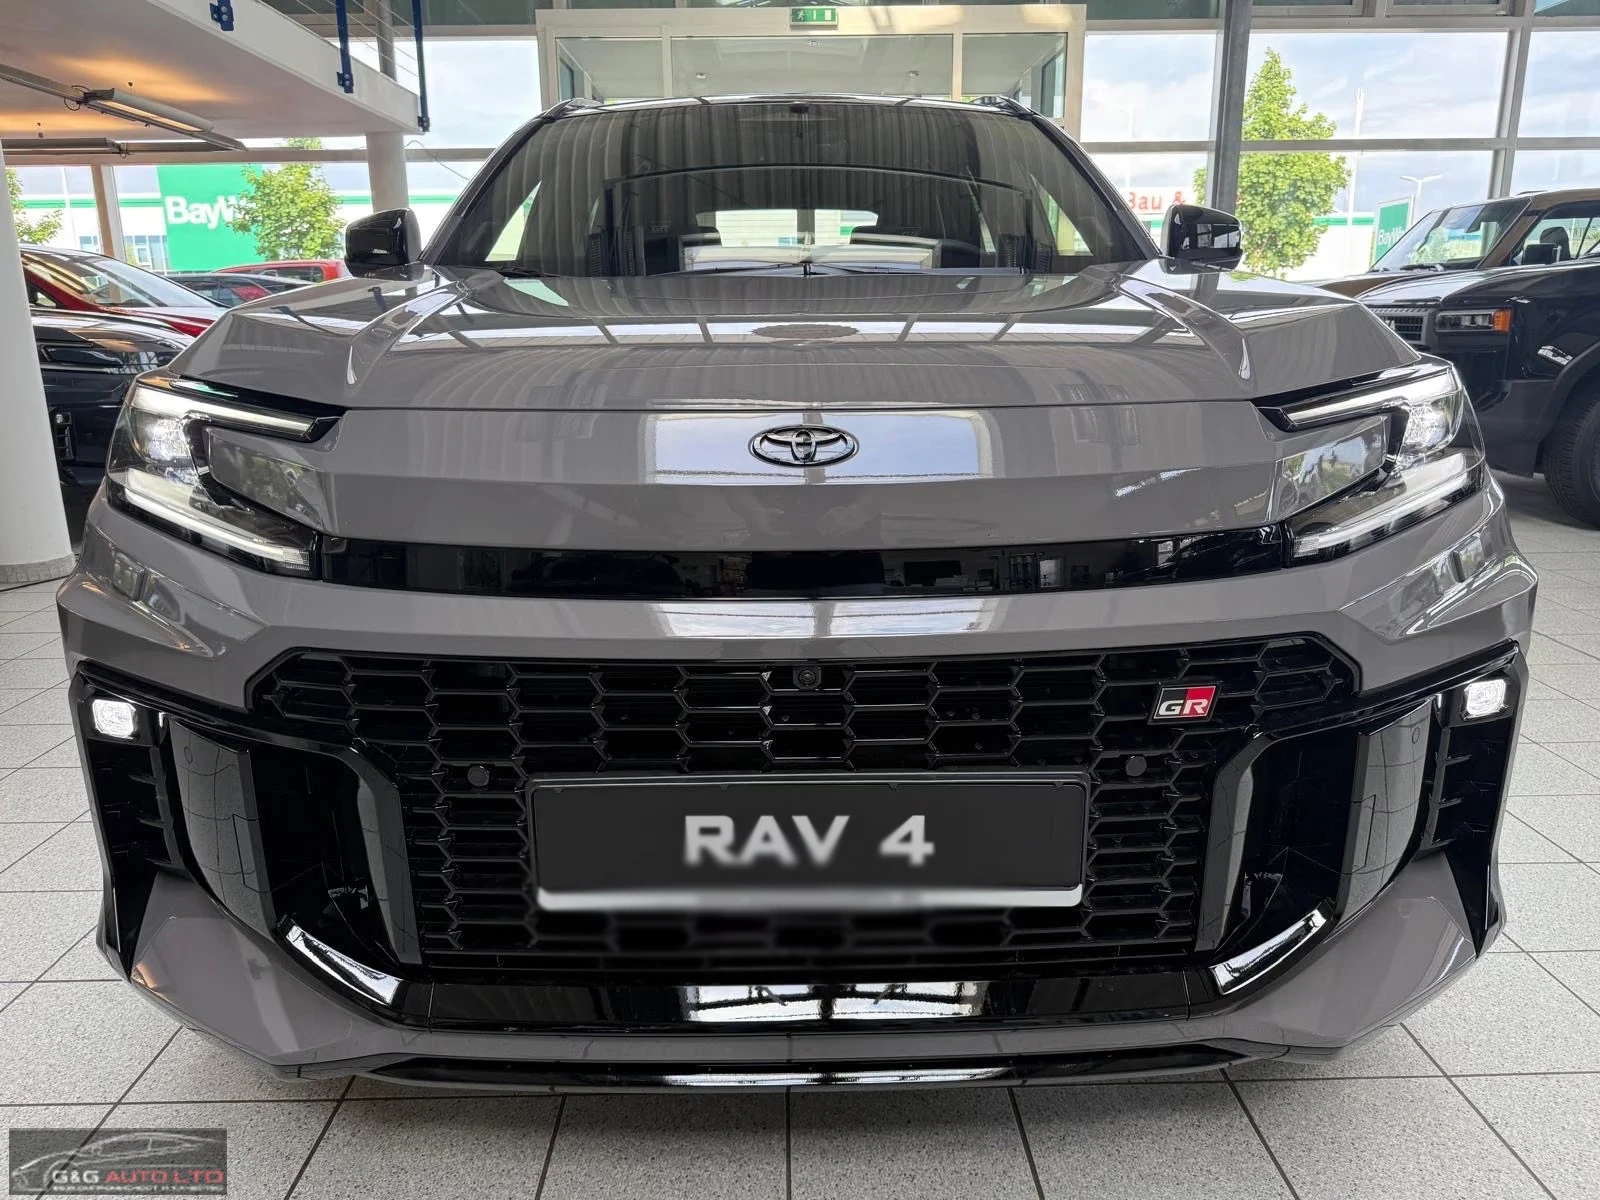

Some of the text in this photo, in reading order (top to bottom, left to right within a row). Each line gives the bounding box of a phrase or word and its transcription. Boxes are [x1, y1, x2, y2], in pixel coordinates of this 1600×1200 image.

[164, 194, 258, 230] BayW
[1158, 698, 1208, 716] GR
[684, 815, 935, 867] RAV 4
